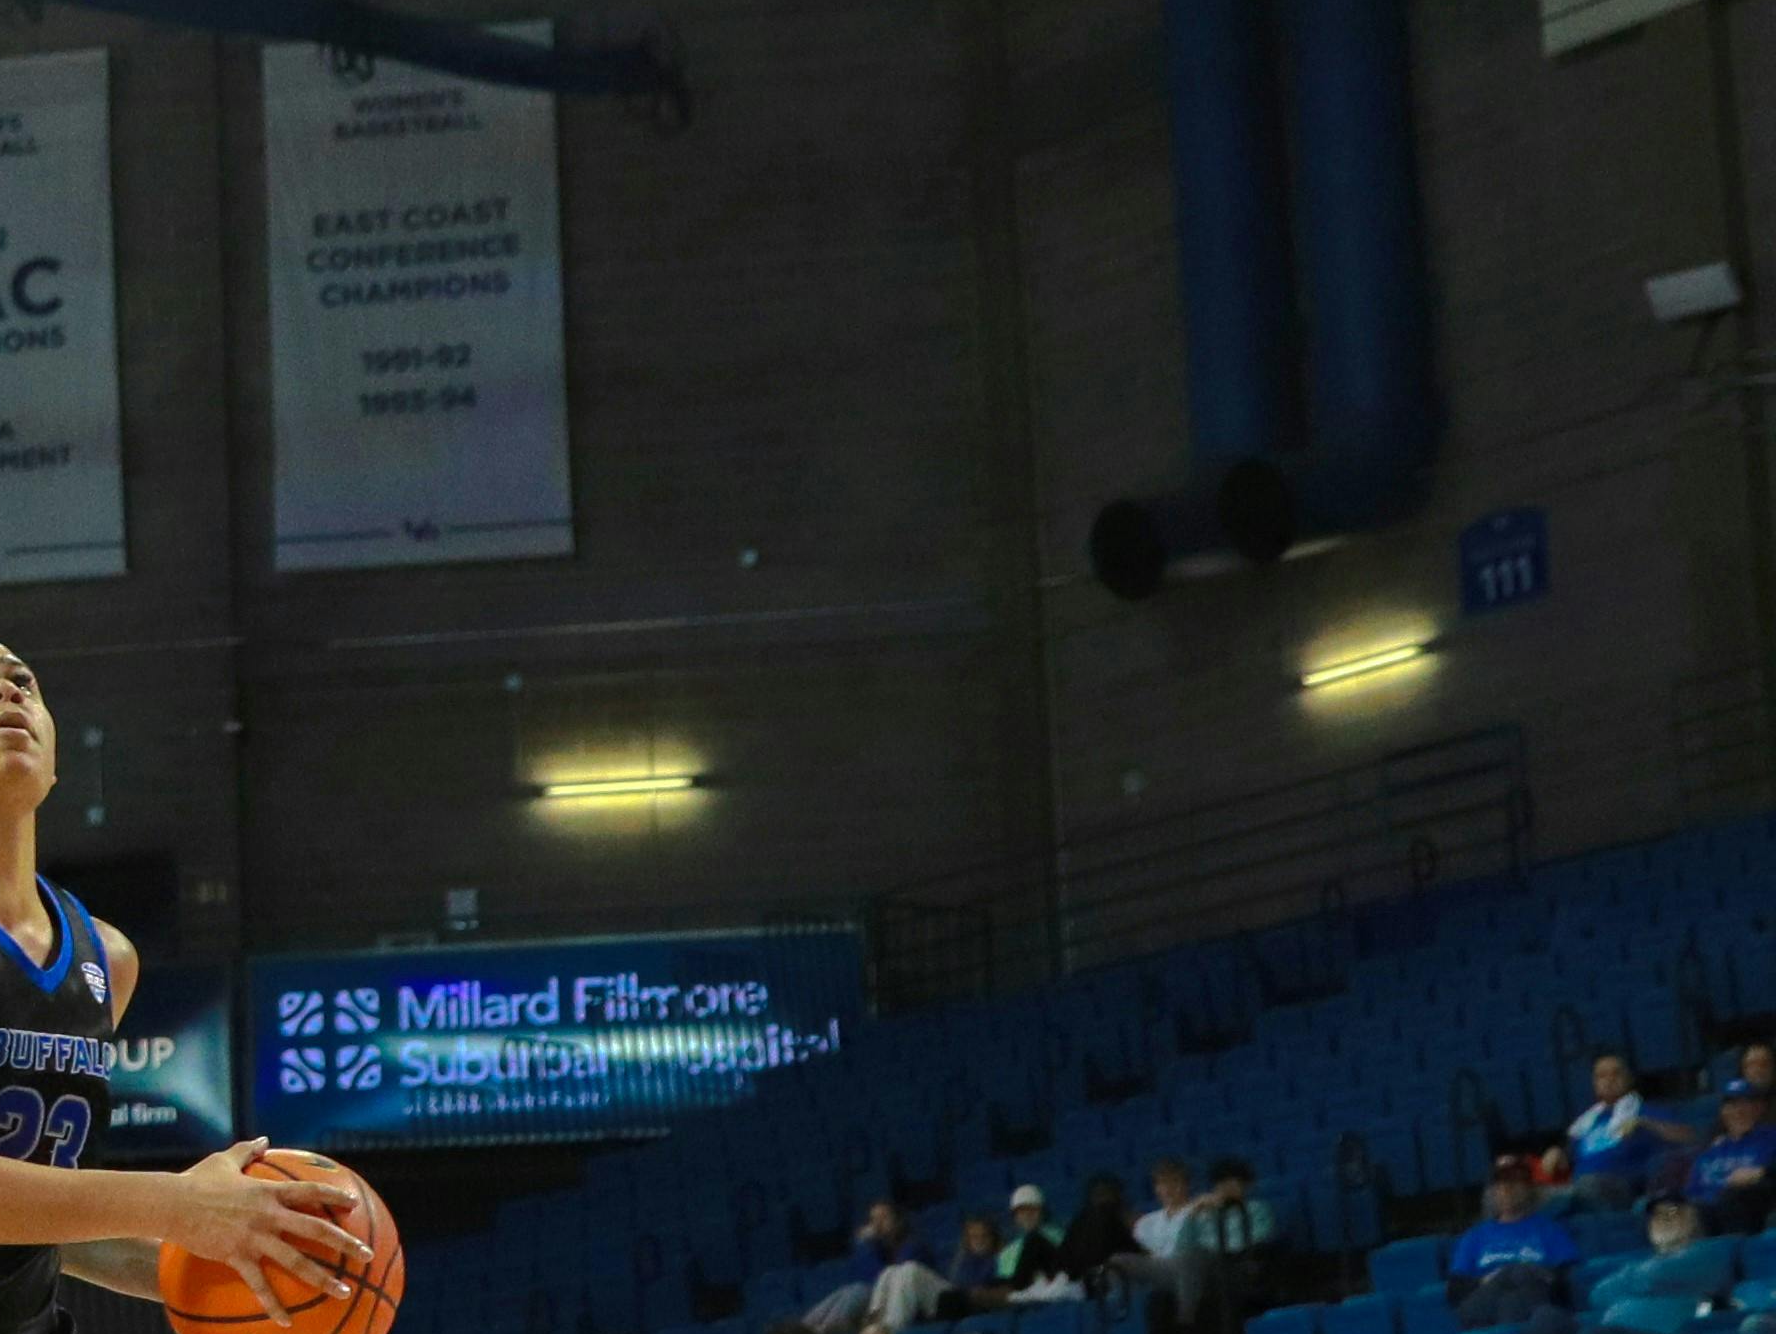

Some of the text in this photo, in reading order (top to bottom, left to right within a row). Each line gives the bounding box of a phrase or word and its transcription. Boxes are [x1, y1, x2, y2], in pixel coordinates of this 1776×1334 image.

[312, 196, 511, 238] EAST COAST
[305, 232, 522, 273] CONFERENCE
[319, 270, 512, 310] CHAMPIONS
[398, 975, 560, 1031] Millard
